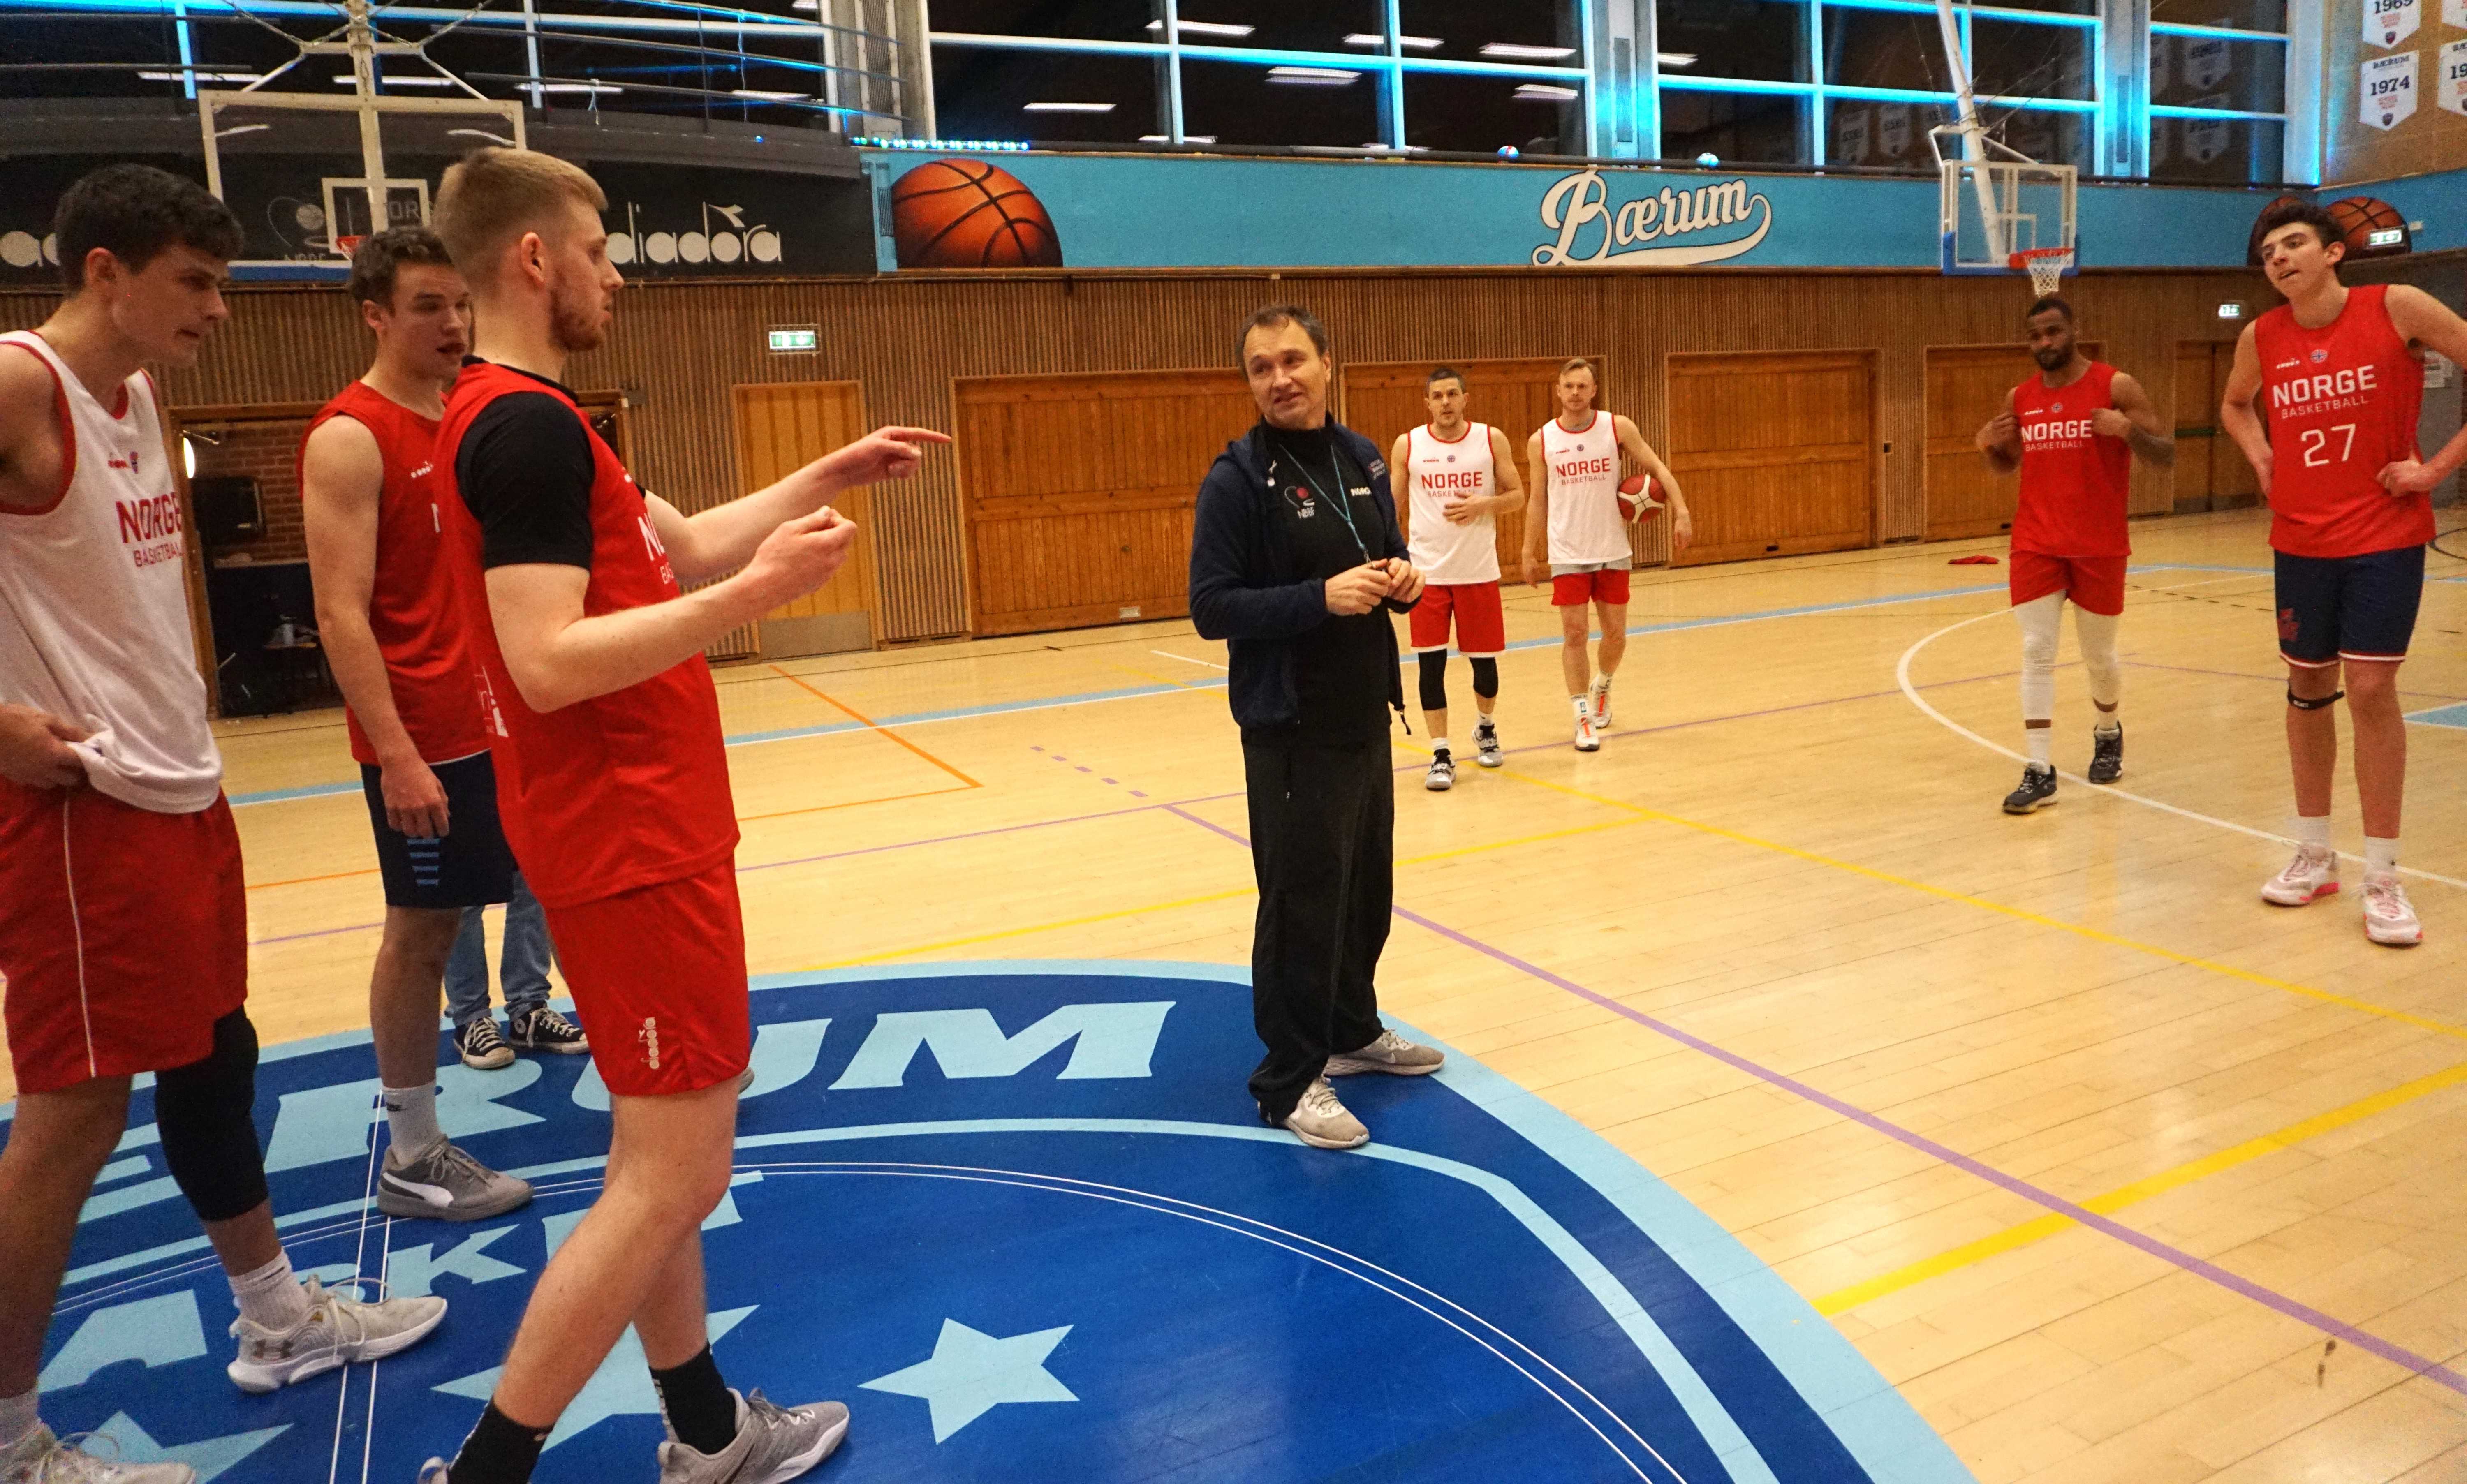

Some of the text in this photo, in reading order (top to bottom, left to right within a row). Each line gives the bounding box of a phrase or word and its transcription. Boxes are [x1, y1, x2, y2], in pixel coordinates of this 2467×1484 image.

[2370, 75, 2410, 96] 1974
[1531, 166, 1772, 265] Bærum
[606, 201, 782, 264] diadora
[2273, 364, 2377, 408] NORGE
[2281, 396, 2369, 420] BASKETBALL
[2021, 419, 2092, 443] NORGE
[2025, 440, 2085, 451] BASKETBALL
[2300, 423, 2356, 467] 27
[1421, 471, 1483, 489] NORGE
[1556, 458, 1611, 478] NORGE
[1561, 474, 1606, 485] BASKETBALL
[115, 492, 182, 544] NORGE
